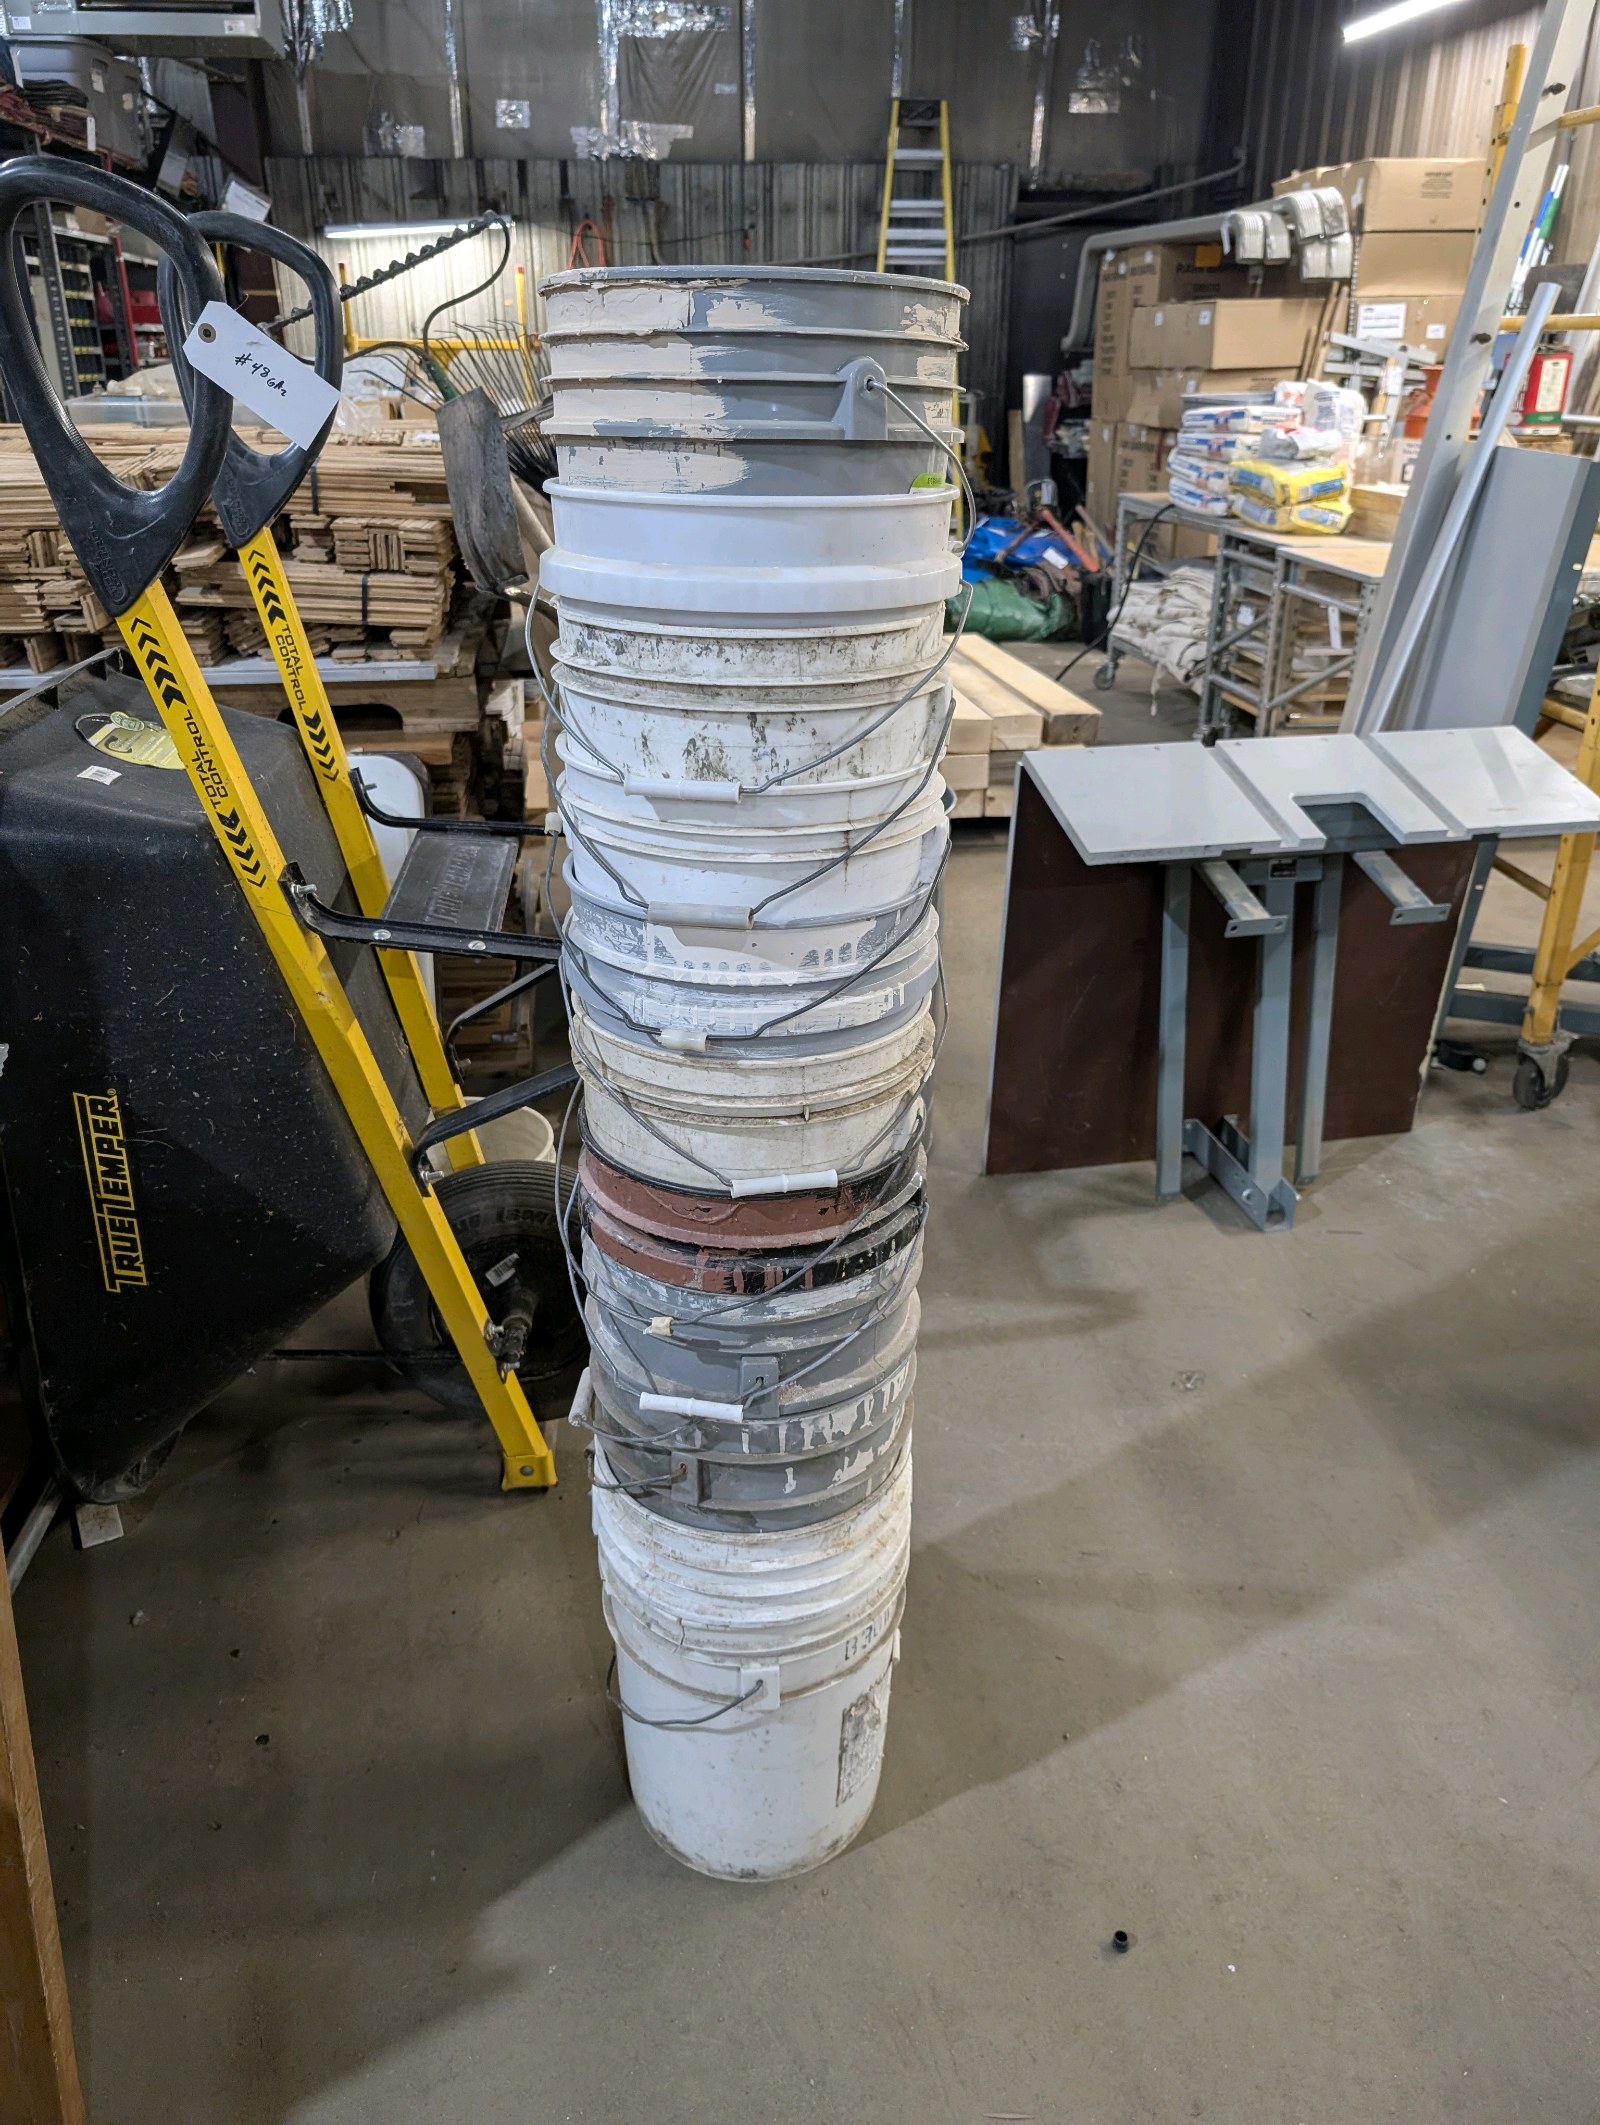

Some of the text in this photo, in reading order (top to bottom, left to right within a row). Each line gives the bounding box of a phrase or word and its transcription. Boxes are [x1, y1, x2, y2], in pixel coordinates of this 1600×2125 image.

[276, 634, 308, 710] CONTROL
[281, 624, 303, 675] TOTAL
[184, 709, 229, 799] CONTROL
[192, 751, 222, 810] TOTAL
[96, 1213, 148, 1293] TRUE
